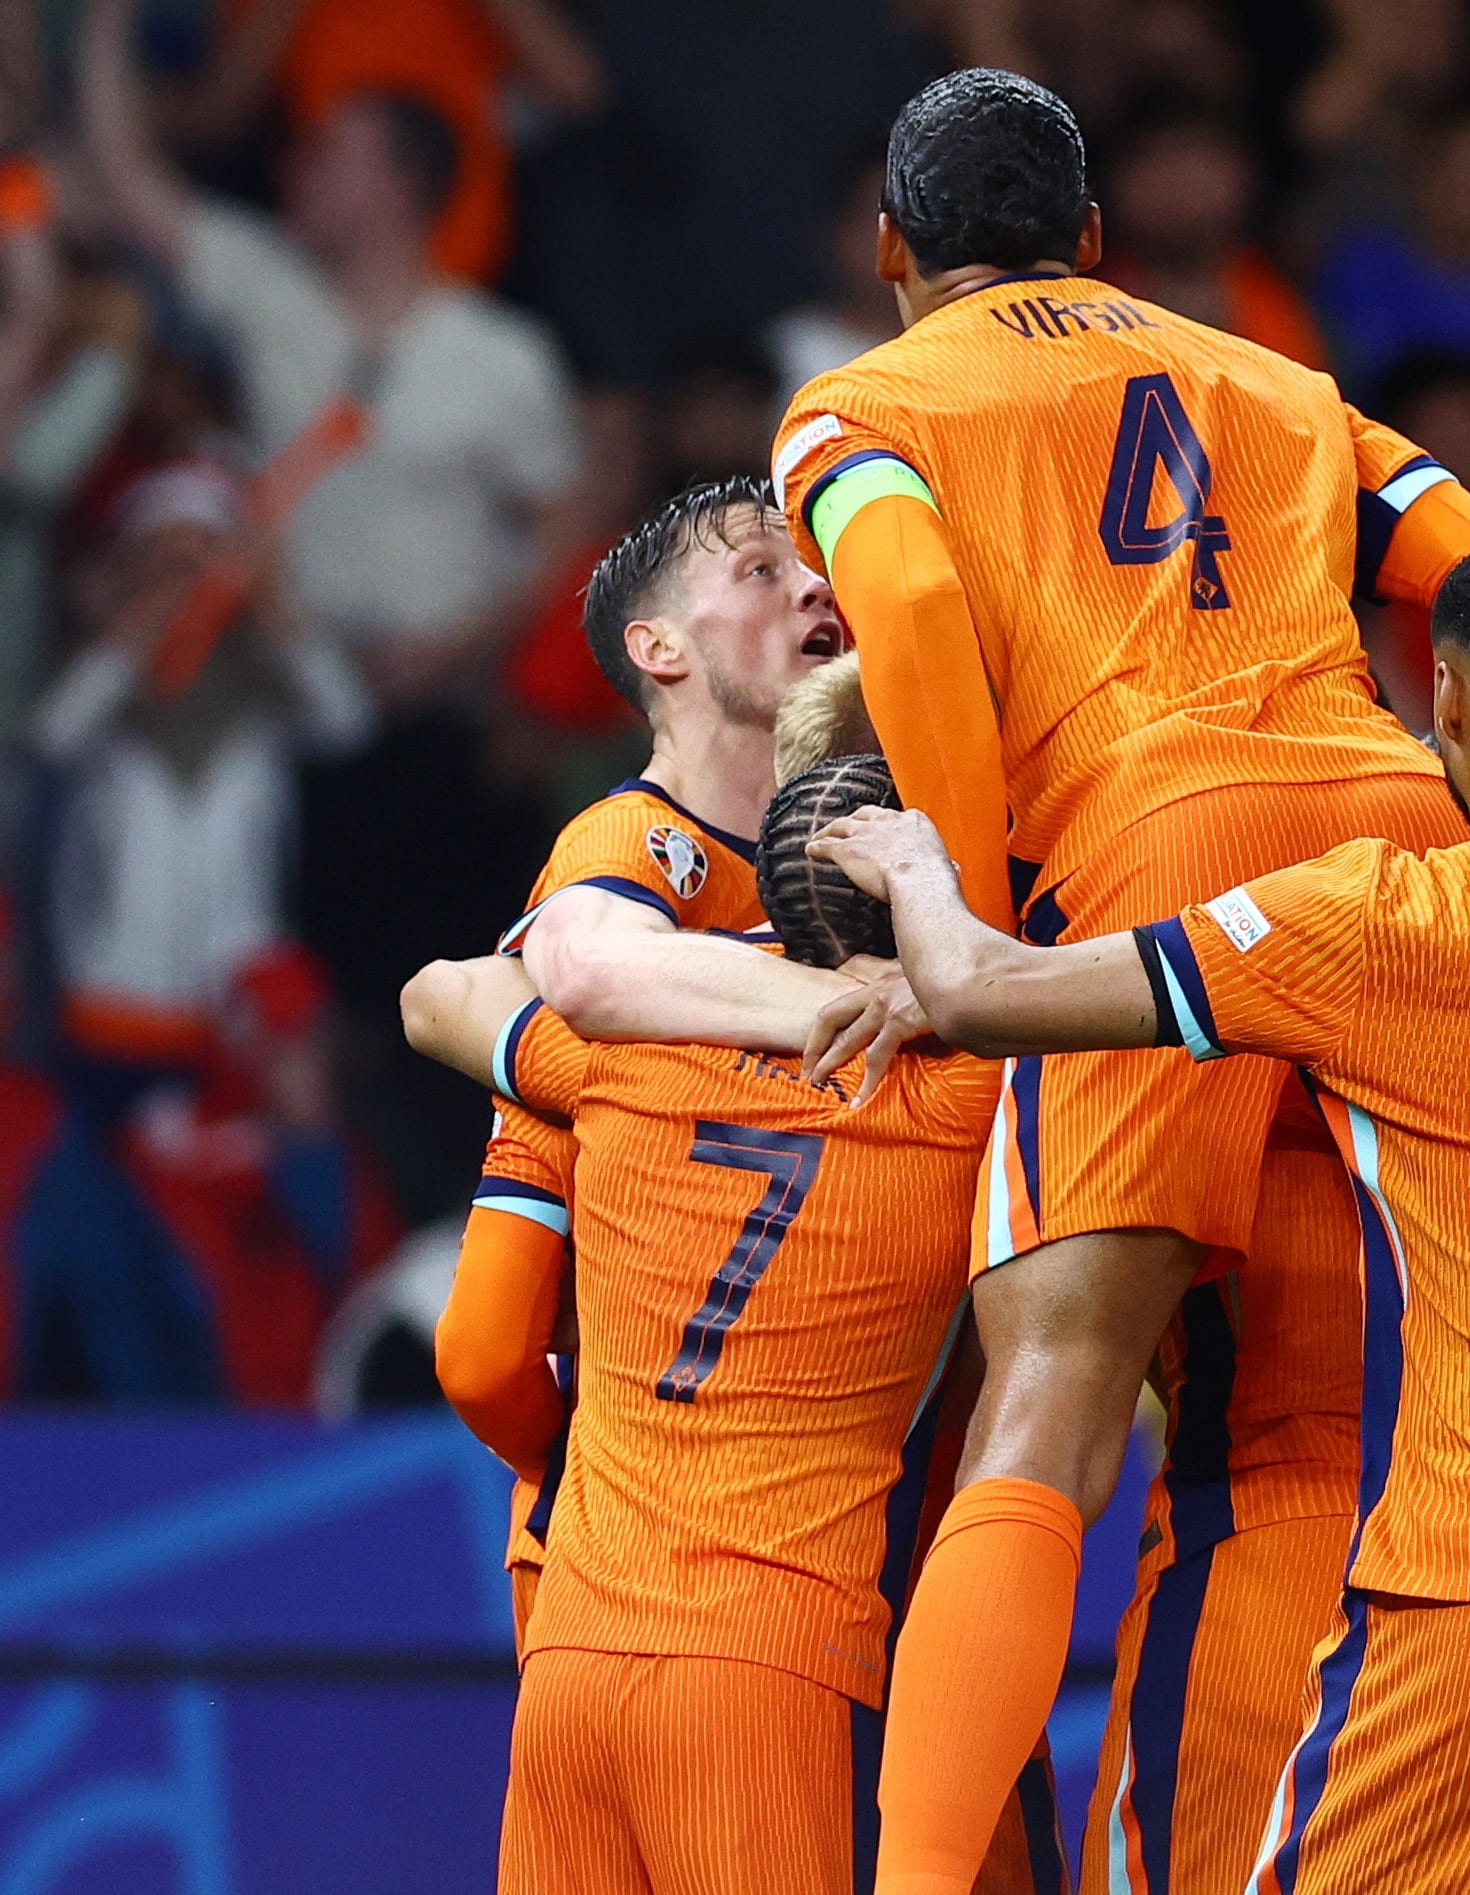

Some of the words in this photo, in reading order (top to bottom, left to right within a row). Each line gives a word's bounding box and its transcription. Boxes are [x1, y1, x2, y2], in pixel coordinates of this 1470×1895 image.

[989, 297, 1161, 338] VIRGIL
[1099, 372, 1231, 609] 4
[1225, 902, 1260, 942] ATION
[655, 1119, 825, 1402] 7
